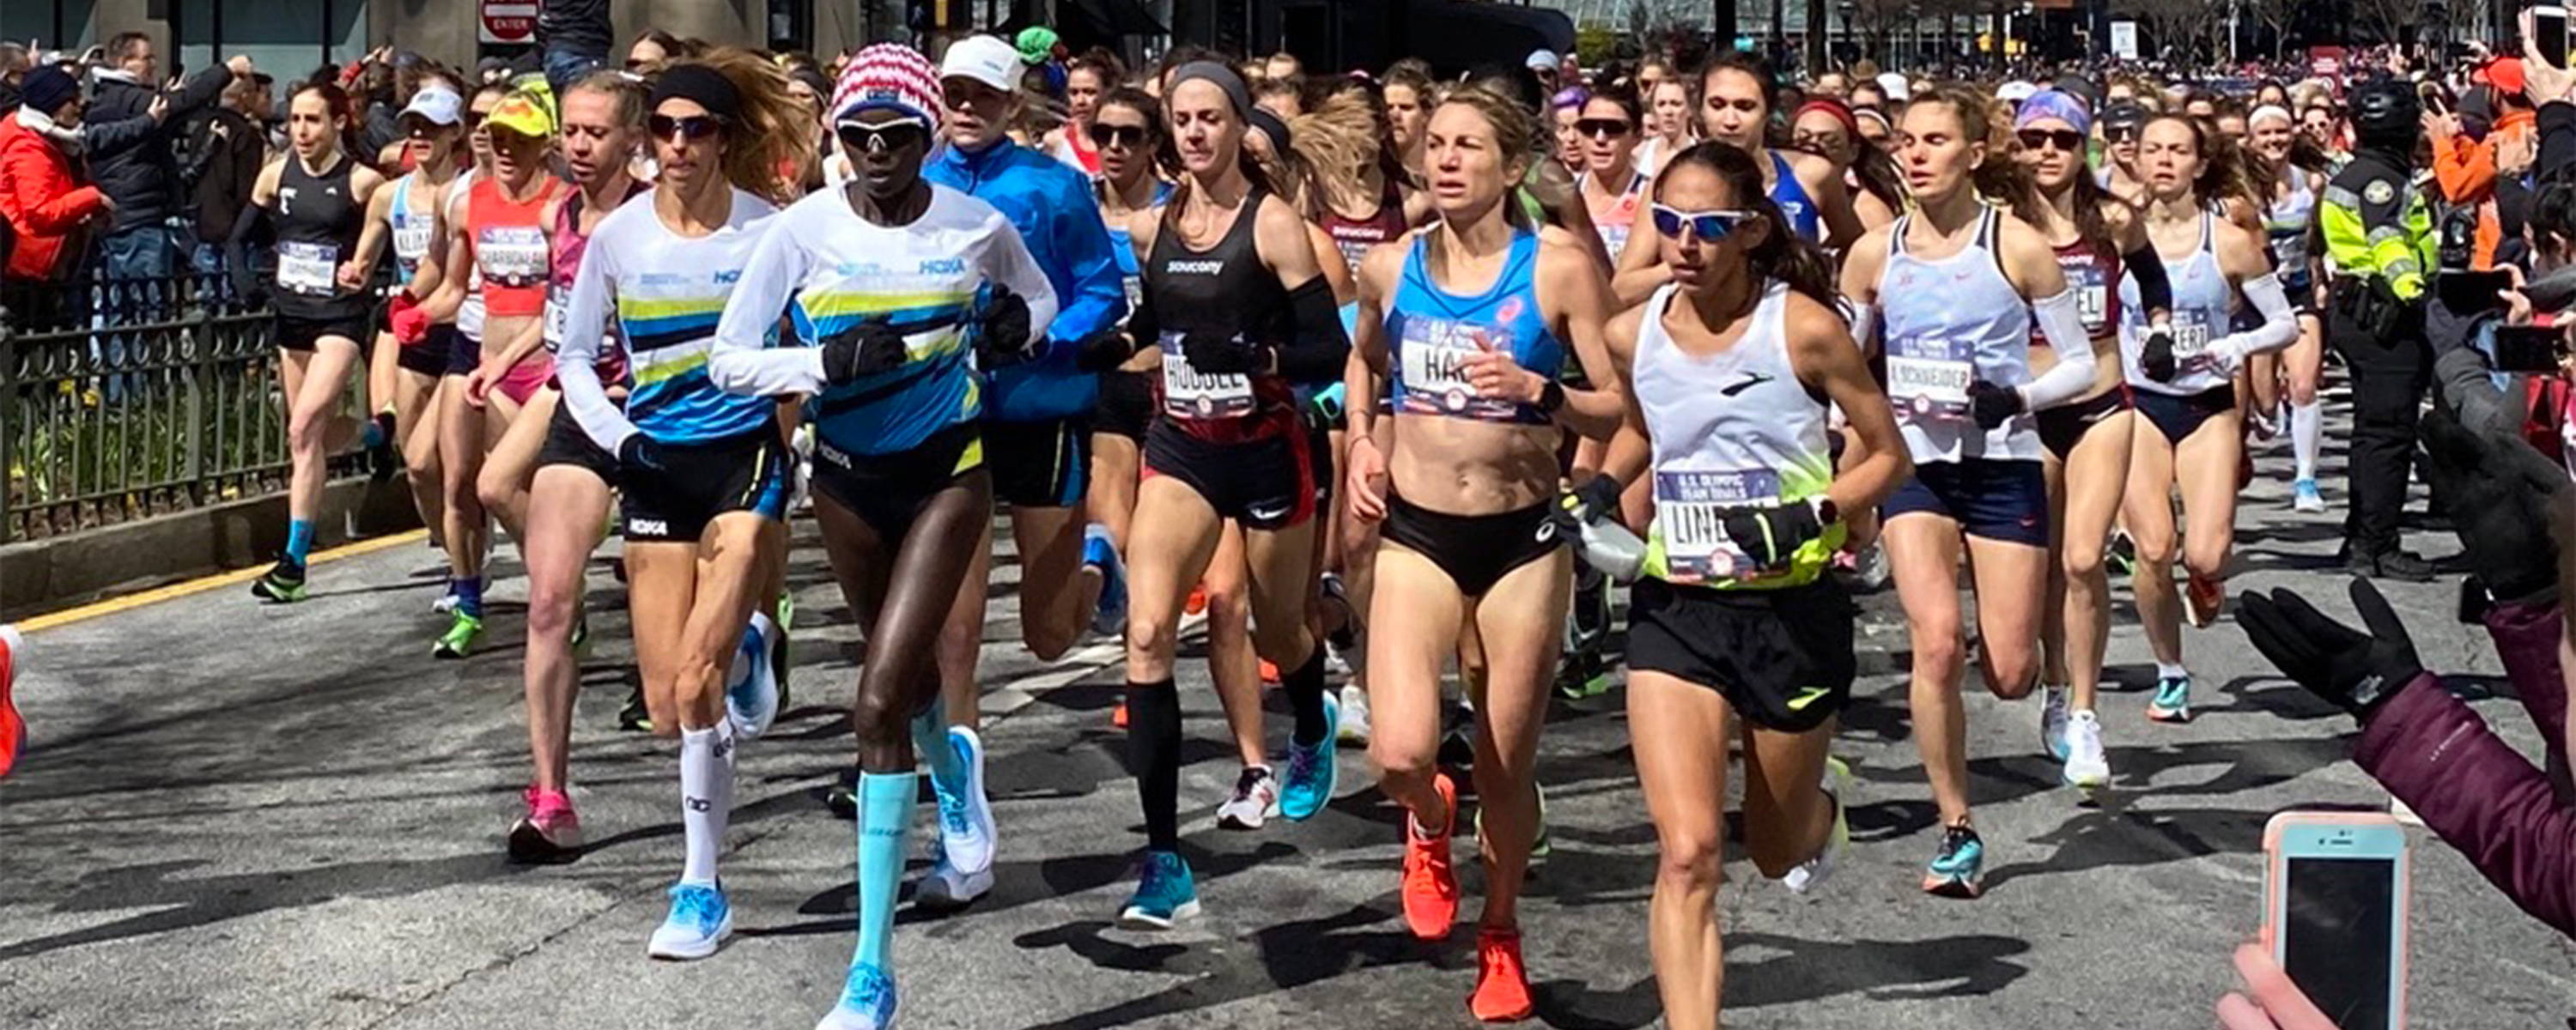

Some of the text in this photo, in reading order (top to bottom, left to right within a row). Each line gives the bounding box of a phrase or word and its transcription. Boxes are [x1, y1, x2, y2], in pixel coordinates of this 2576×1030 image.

[494, 19, 528, 29] ENTER
[919, 258, 966, 275] HOKA
[1166, 260, 1224, 276] saucony
[713, 270, 744, 284] HO
[1425, 349, 1472, 383] HAL
[1700, 474, 1745, 487] OLYMPIC
[1680, 488, 1708, 500] TEAM
[629, 518, 668, 536] HOKA
[1673, 504, 1747, 543] LIN
